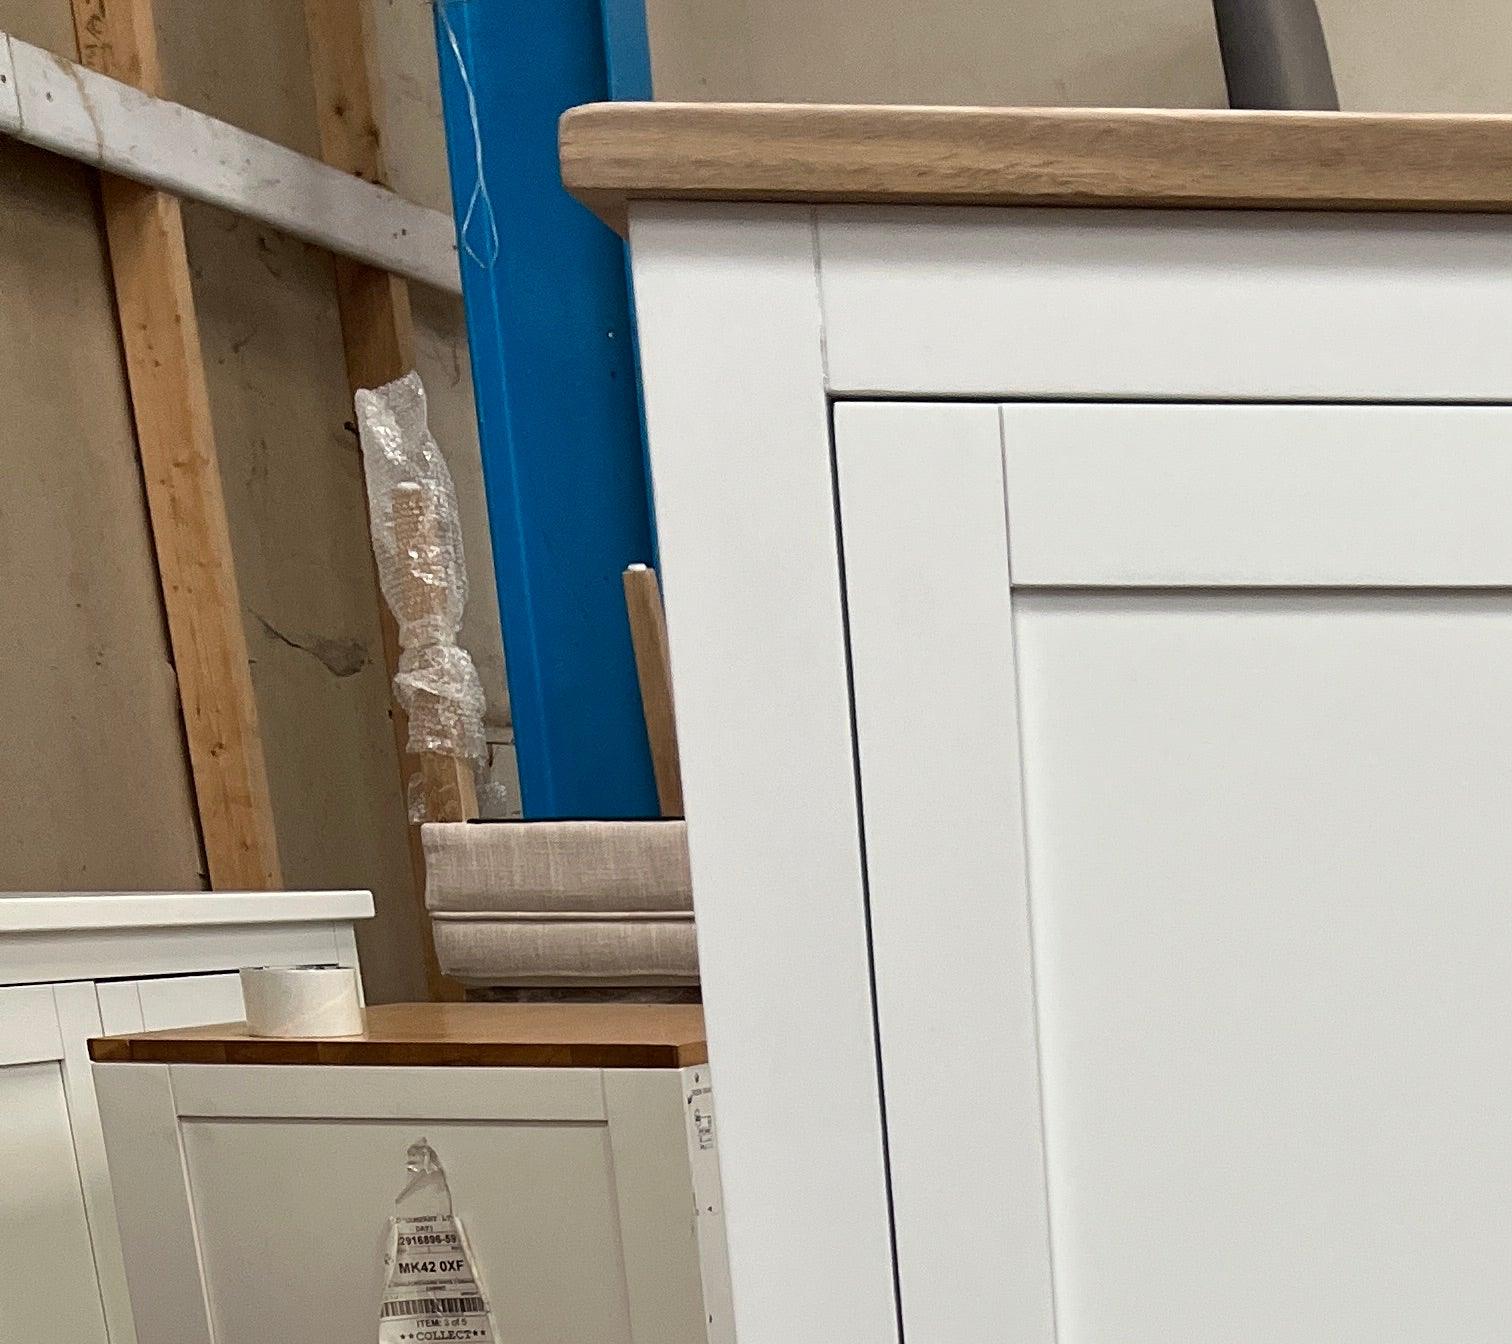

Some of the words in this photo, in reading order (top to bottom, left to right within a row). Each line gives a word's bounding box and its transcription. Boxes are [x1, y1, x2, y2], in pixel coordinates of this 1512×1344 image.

[398, 1261, 436, 1274] MK42
[416, 1319, 441, 1328] ITEM:
[451, 1318, 460, 1327] of
